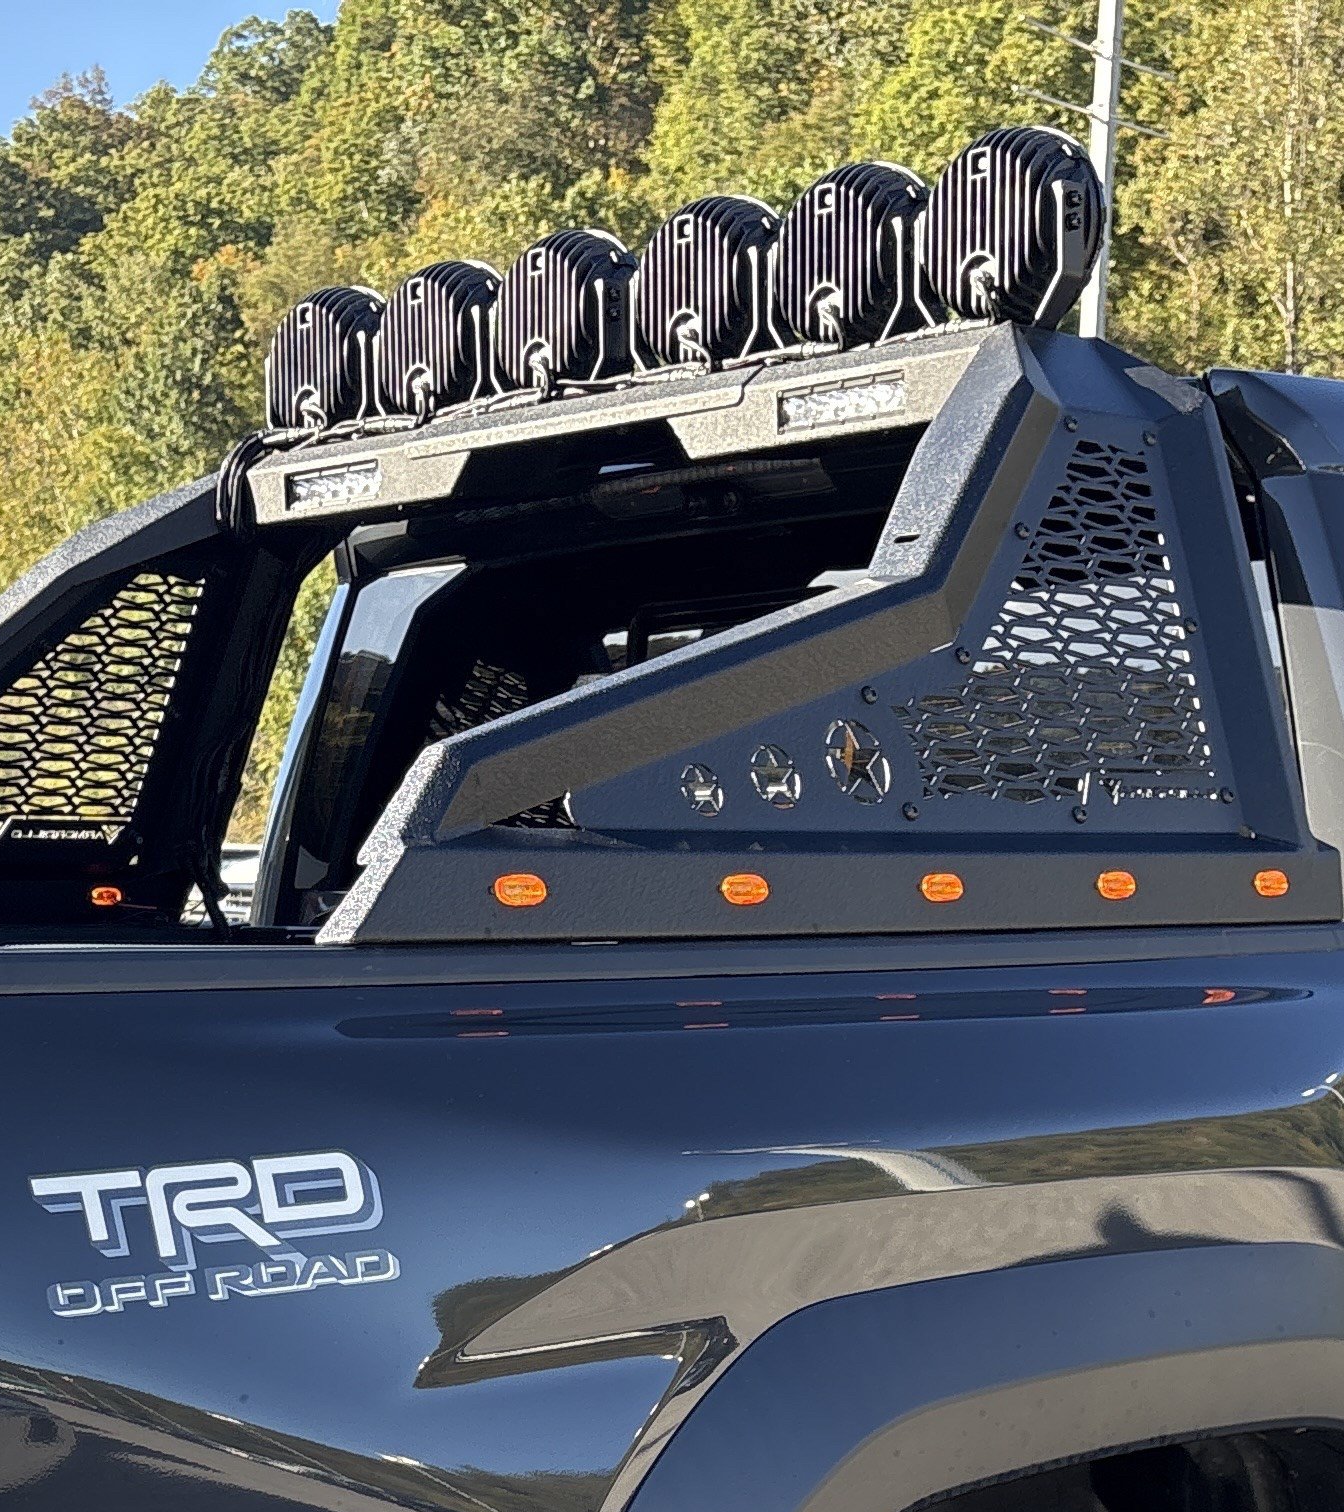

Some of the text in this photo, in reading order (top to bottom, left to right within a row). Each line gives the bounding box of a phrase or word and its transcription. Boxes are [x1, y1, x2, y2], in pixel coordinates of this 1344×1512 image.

[28, 1149, 384, 1272] TRD
[47, 1249, 401, 1318] OFF ROAD
